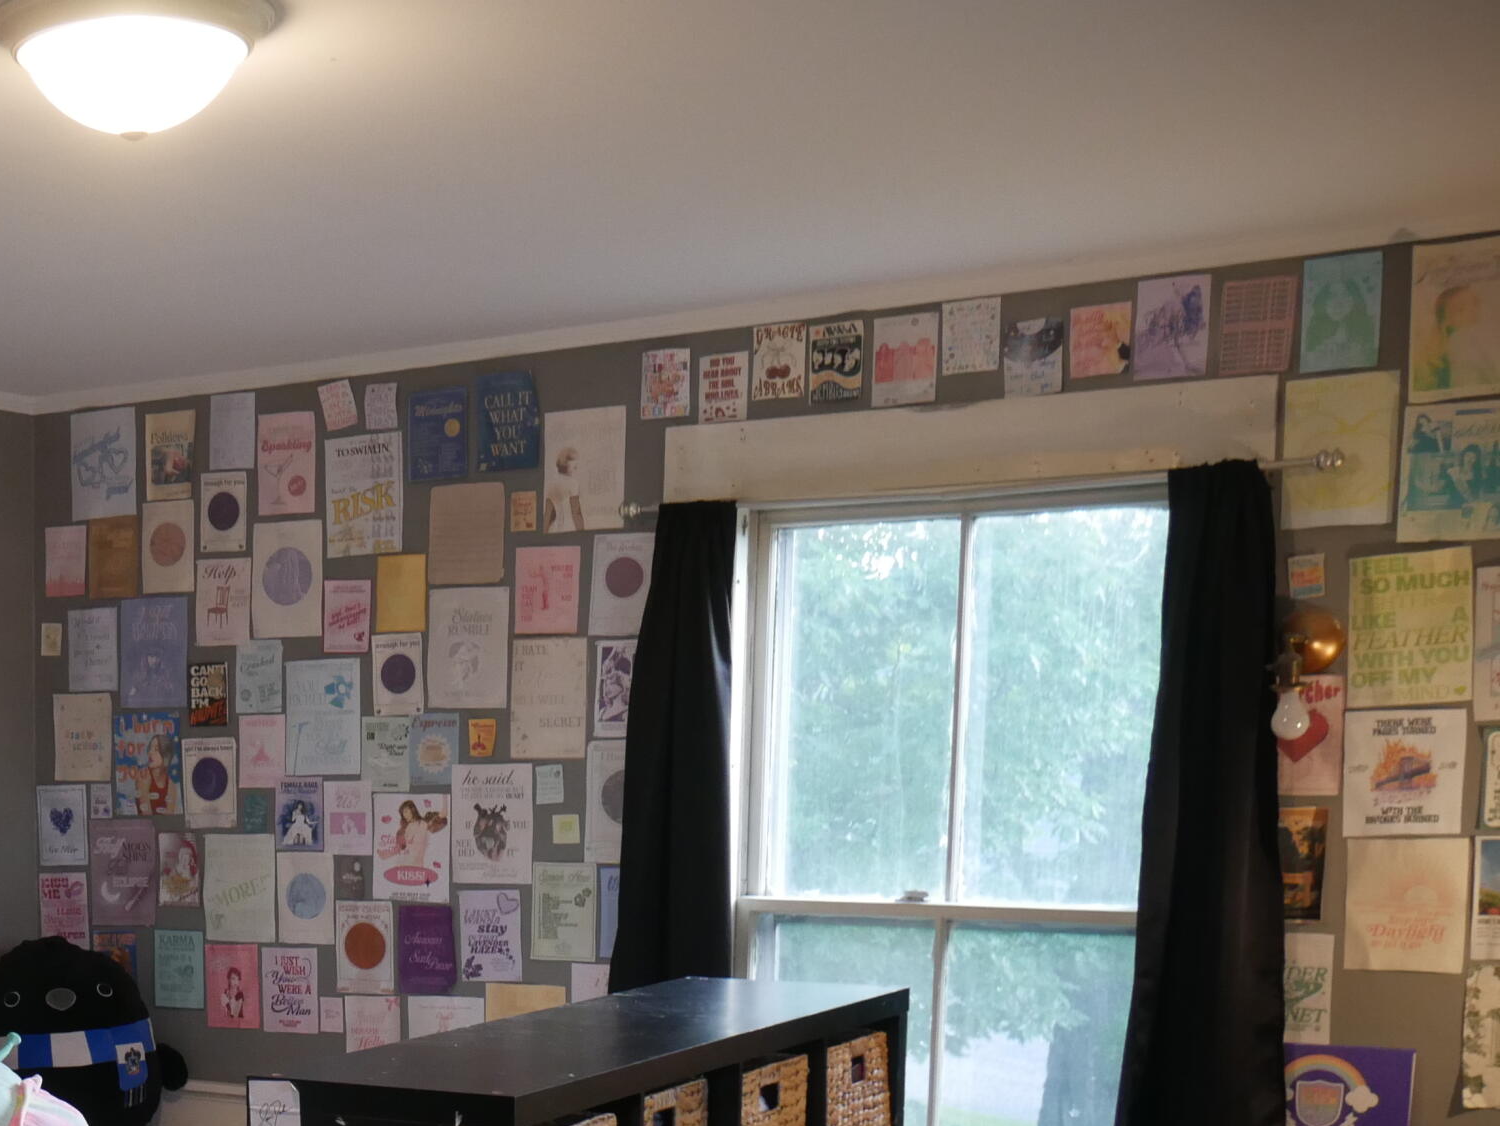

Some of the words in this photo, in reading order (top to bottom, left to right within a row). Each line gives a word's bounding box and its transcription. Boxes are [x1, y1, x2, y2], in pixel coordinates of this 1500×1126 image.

[484, 393, 514, 410] CALL
[516, 391, 533, 406] IT
[489, 409, 526, 425] WHAT
[493, 425, 522, 441] YOU
[490, 441, 527, 457] WANT
[332, 480, 396, 525] RISK
[202, 564, 236, 585] Help
[1361, 556, 1414, 575] FEEL
[1360, 576, 1390, 595] SO
[1396, 570, 1470, 592] MUCH
[1352, 611, 1396, 631] LIKE
[1452, 606, 1468, 624] A
[1353, 625, 1470, 651] FEATHER
[1356, 651, 1414, 669] WITH
[1420, 647, 1470, 665] YOU
[191, 676, 208, 687] GO
[1353, 672, 1393, 689] OFF
[1399, 667, 1438, 685] MY
[1396, 684, 1450, 701] MIND
[117, 739, 146, 758] for
[116, 764, 148, 783] you
[462, 769, 478, 785] he
[477, 922, 508, 937] stay
[280, 955, 300, 967] JUST
[283, 966, 306, 976] WISH
[277, 984, 303, 995] WERE
[305, 984, 312, 994] A
[286, 1003, 311, 1016] Man
